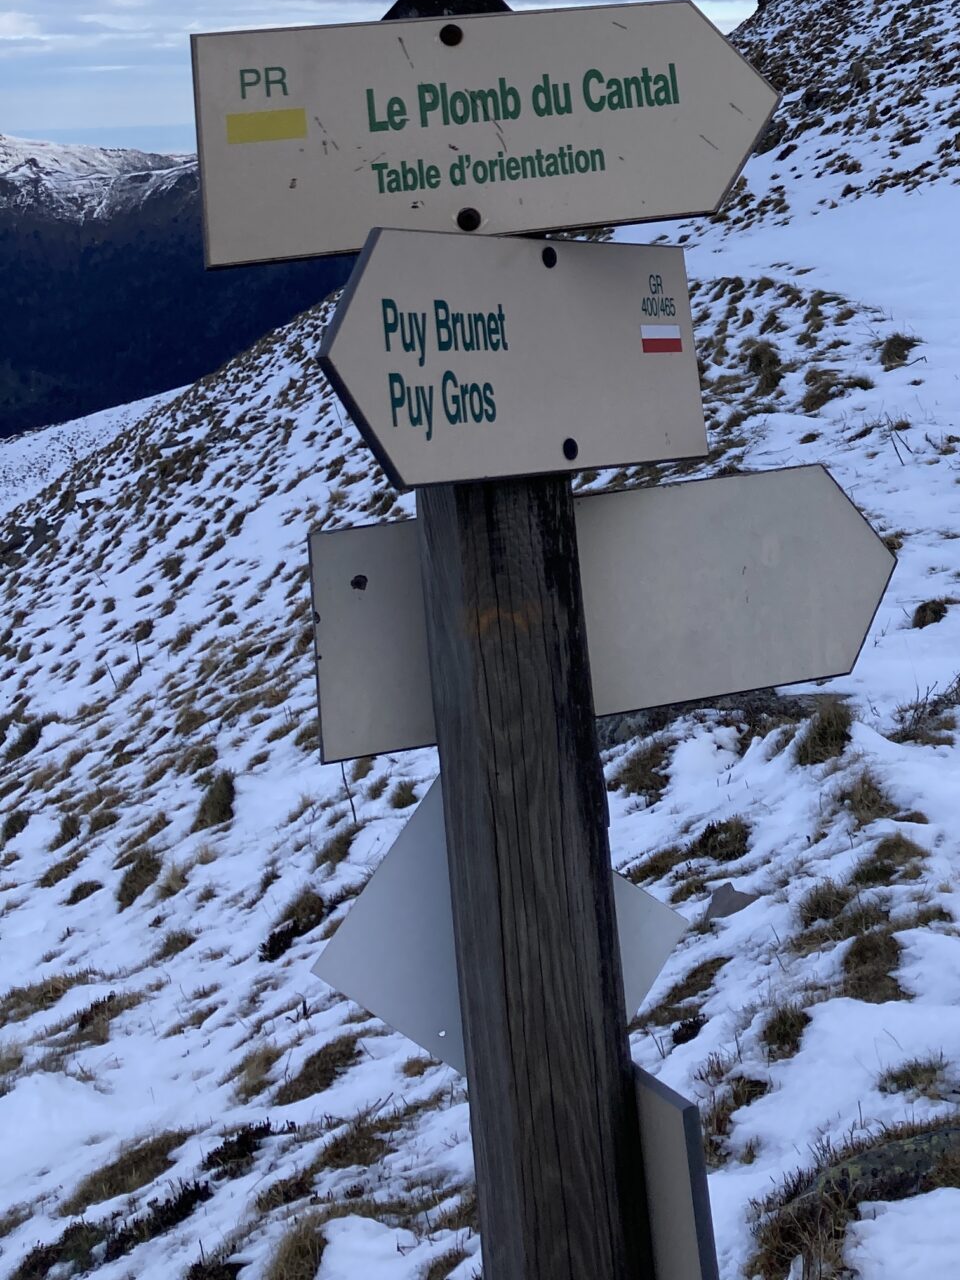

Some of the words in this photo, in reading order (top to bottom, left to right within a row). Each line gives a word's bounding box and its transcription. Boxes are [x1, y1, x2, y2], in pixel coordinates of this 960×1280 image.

[239, 66, 288, 99] PR
[366, 87, 408, 132] Le
[418, 77, 522, 128] Plomb
[532, 73, 573, 117] du
[583, 63, 679, 112] Cantal
[372, 159, 441, 194] Table
[450, 145, 606, 186] d'orientation
[649, 274, 664, 295] GR
[382, 298, 426, 367] Puy
[434, 300, 508, 352] Brunet
[389, 372, 433, 441] Puy
[442, 370, 496, 425] Gros
